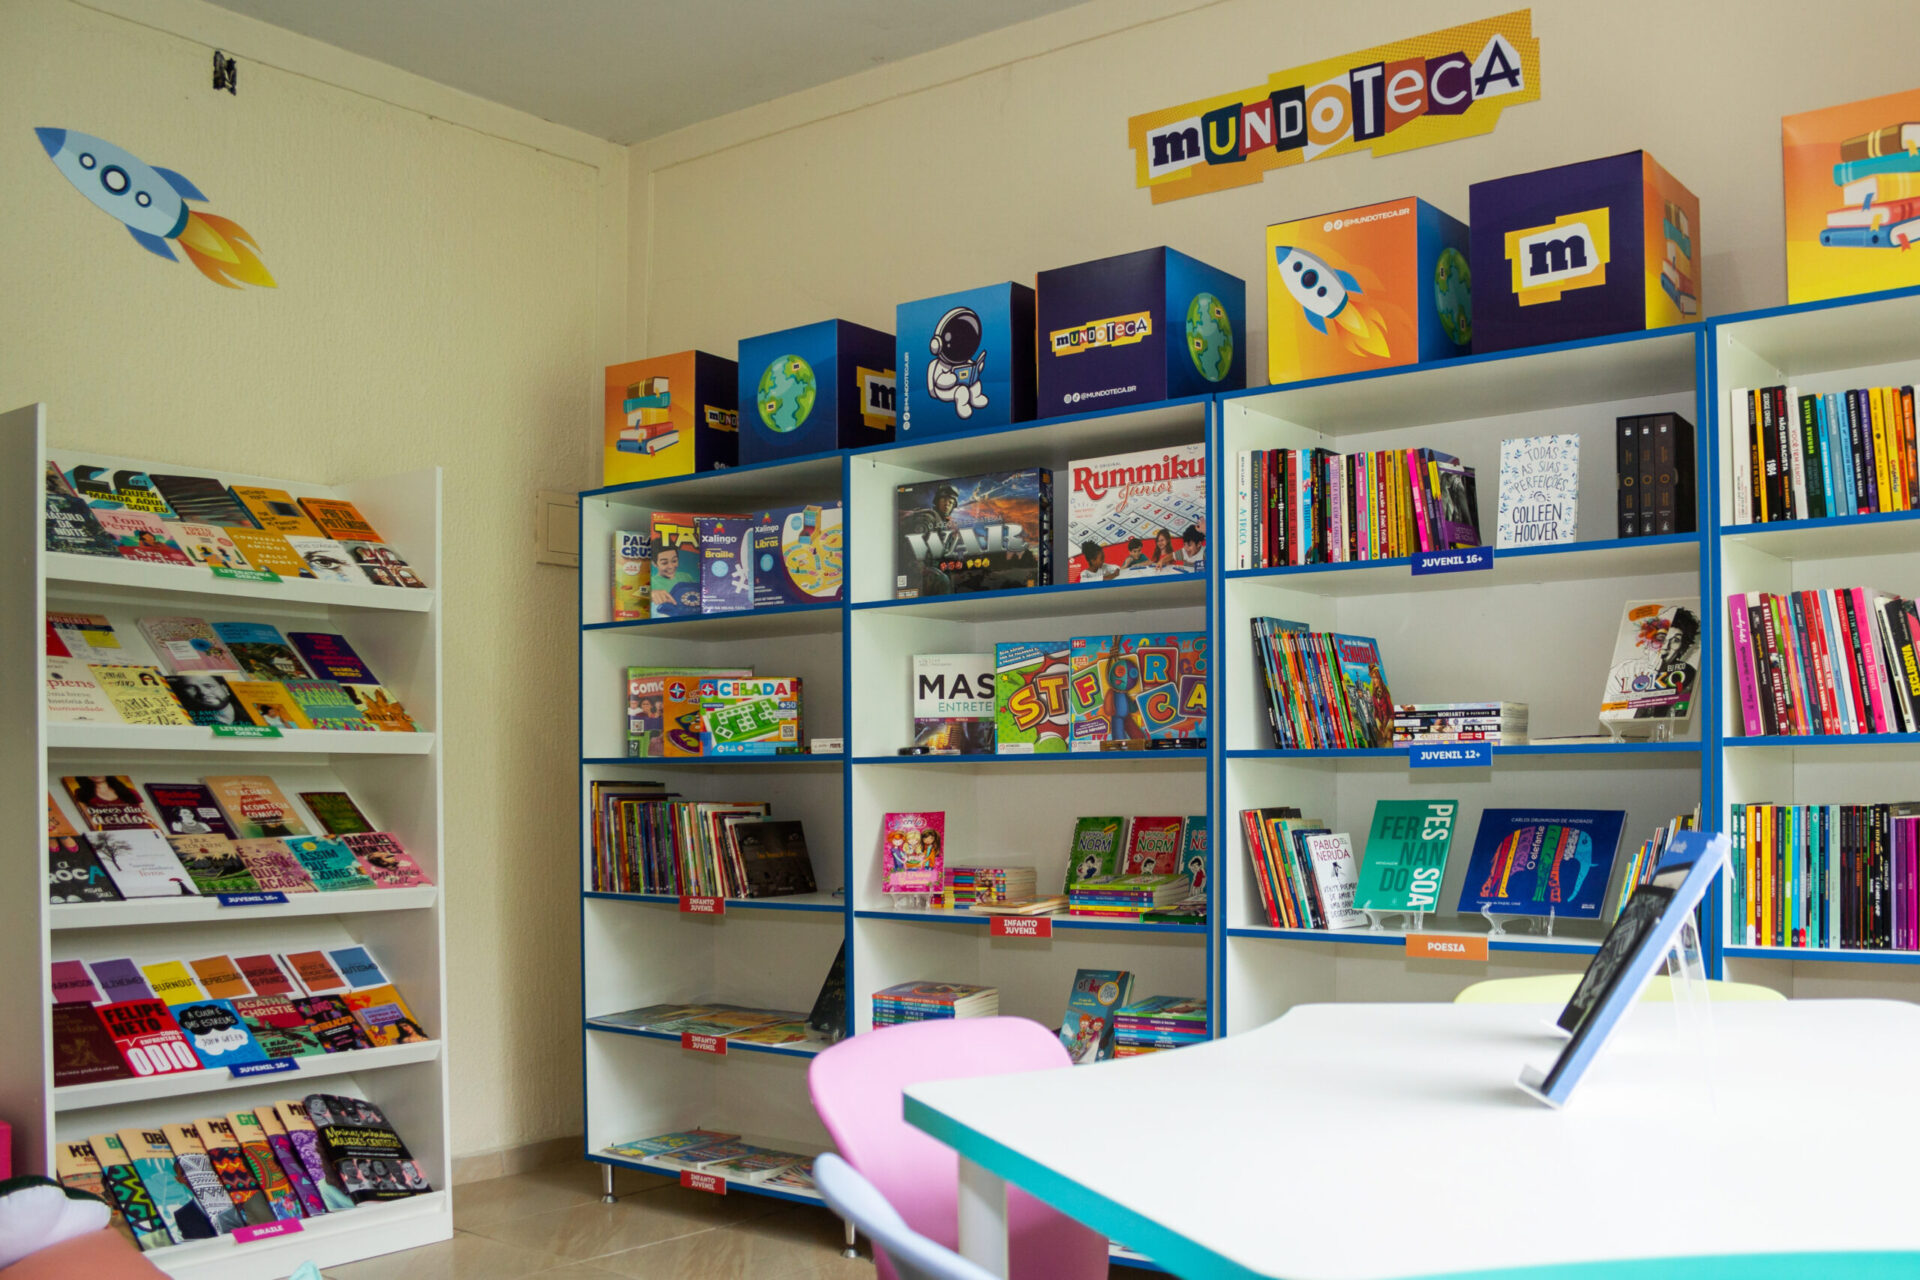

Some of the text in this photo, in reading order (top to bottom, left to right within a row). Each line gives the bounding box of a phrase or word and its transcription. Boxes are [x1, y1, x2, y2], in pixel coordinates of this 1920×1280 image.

[1528, 234, 1588, 277] m
[1778, 416, 1789, 472] NÃO SER RACISTA
[1524, 446, 1558, 461] TODAS
[1538, 461, 1561, 474] SUAS
[1765, 459, 1777, 476] 1984
[1073, 454, 1206, 501] Rummiku
[1511, 502, 1562, 525] COLLEEN
[54, 527, 87, 537] NOITE
[653, 522, 700, 549] TA
[754, 523, 780, 534] Xalingo
[1514, 521, 1559, 543] HOOVER
[701, 534, 738, 544] Xalingo
[753, 539, 779, 549] Libras
[905, 522, 1024, 563] WAR
[704, 550, 735, 559] Braille
[1421, 554, 1483, 568] JUVENIL 16+
[1762, 607, 1772, 621] MÃE
[1764, 622, 1776, 649] PERFEITA
[1863, 642, 1874, 663] Luiza
[1901, 644, 1920, 697] EXCLUSIVA
[719, 682, 789, 697] CILADA
[918, 673, 996, 700] MAS
[1772, 672, 1785, 714] AIMEE MOLLOY
[1009, 673, 1071, 730] ST
[1421, 750, 1481, 760] JUVENIL 12+
[1379, 815, 1420, 841] FER
[1421, 803, 1455, 841] PES
[342, 834, 398, 847] RAPHAEL
[1078, 838, 1112, 852] NORM
[1136, 838, 1174, 852] NORM
[1190, 838, 1207, 850] NO
[1313, 838, 1341, 850] PABLO
[1530, 825, 1546, 861] elefante
[300, 849, 340, 860] ASSIM
[1316, 848, 1351, 861] NERUDA
[1399, 841, 1446, 867] NAN
[304, 859, 330, 870] QUE
[48, 865, 106, 885] ROCA
[1378, 867, 1410, 893] DO
[259, 879, 305, 891] ACABA
[1406, 867, 1441, 908] SOA
[228, 894, 263, 903] JUVENIL
[690, 898, 715, 906] INFANTO
[1003, 919, 1038, 929] INFANTO
[1005, 926, 1037, 936] JUVENIL
[1427, 941, 1466, 953] POESIA
[152, 977, 195, 993] BURNOUT
[236, 995, 291, 1010] AGATHA
[102, 1002, 166, 1024] FELIPE
[240, 1004, 297, 1019] CHRISTIE
[110, 1018, 162, 1038] NETO
[692, 1035, 718, 1045] INFANTO
[692, 1042, 716, 1051] JUVENIL
[239, 1063, 274, 1074] JUVENIL
[690, 1173, 717, 1185] INFANTO
[691, 1180, 716, 1190] JUVENIL
